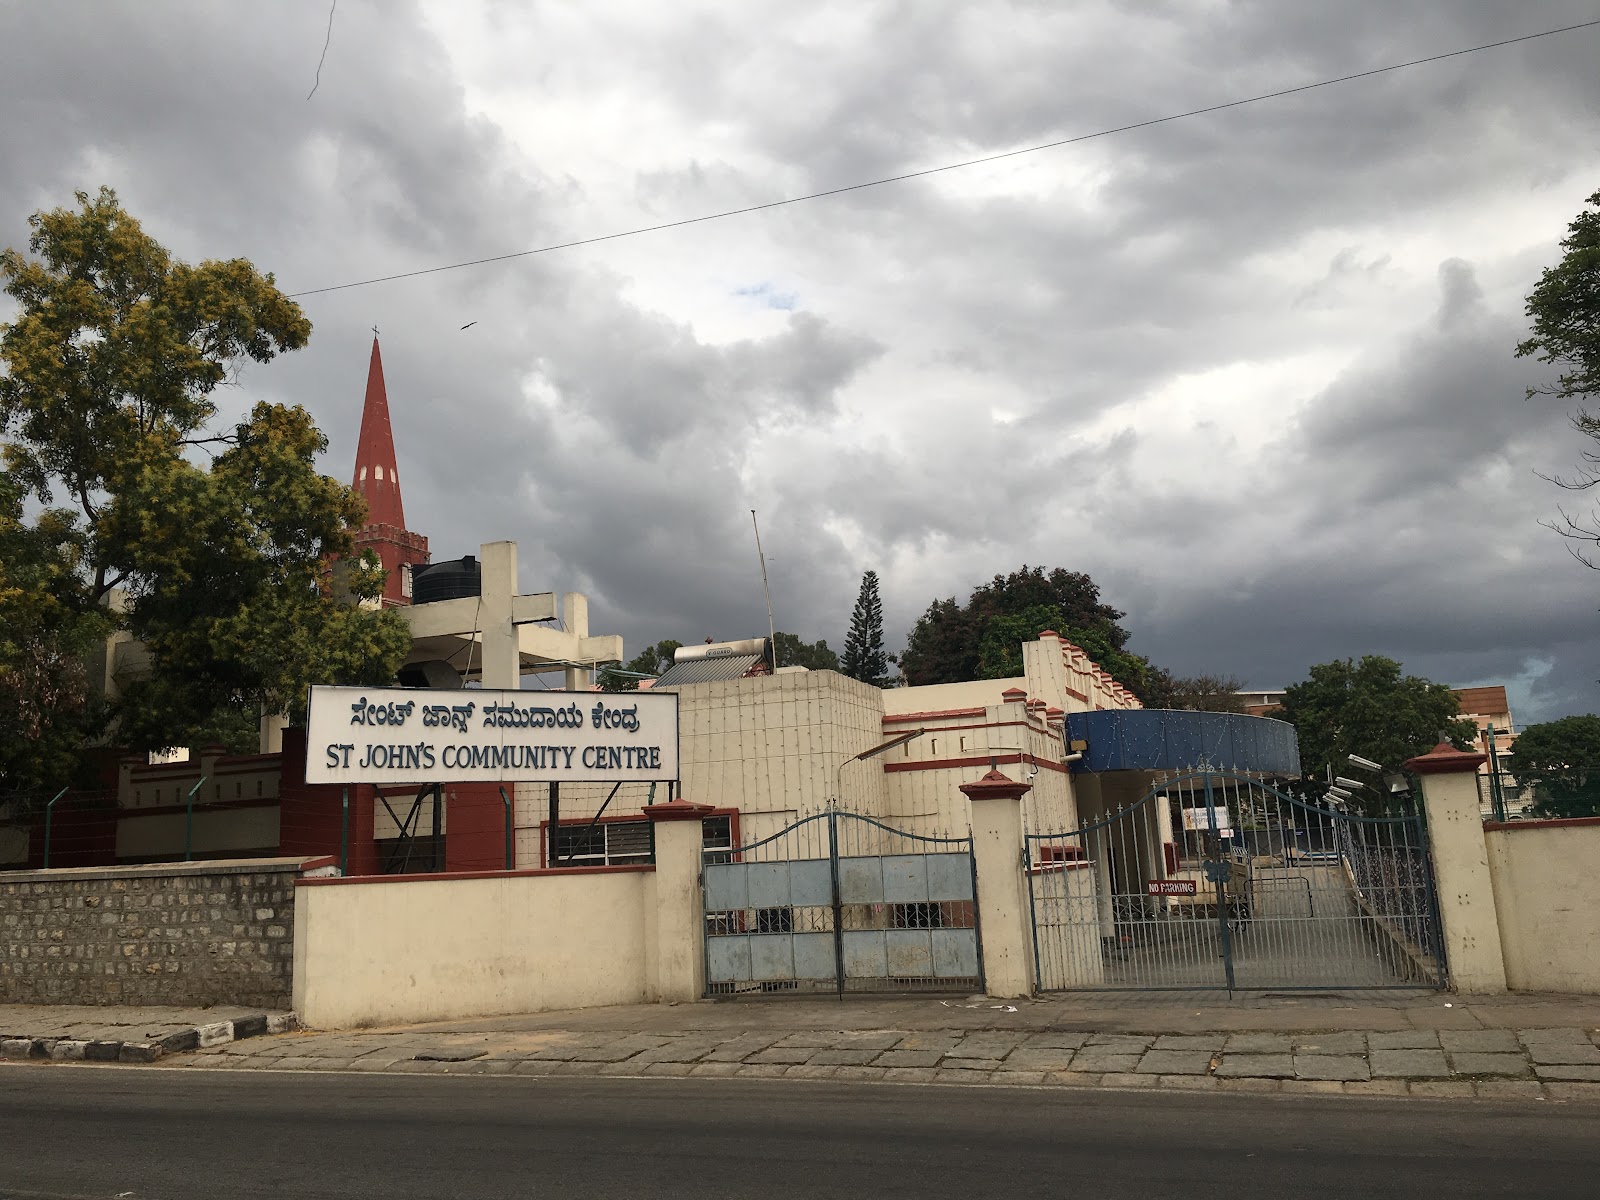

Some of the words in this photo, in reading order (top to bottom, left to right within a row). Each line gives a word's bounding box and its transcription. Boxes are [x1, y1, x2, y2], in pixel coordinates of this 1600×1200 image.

[351, 696, 416, 726] ಸೇಂಟ್
[422, 701, 476, 733] ಜಾನ್ಸ್
[483, 700, 583, 728] ಸಮುದಾಯ
[591, 701, 641, 733] ಕೇಂದ್ರ
[326, 743, 355, 769] ST
[359, 741, 436, 769] JOHN'S
[442, 744, 576, 770] COMMUNITY
[582, 745, 662, 770] CENTRE
[1148, 883, 1159, 893] NO
[1160, 883, 1195, 893] PARKING
